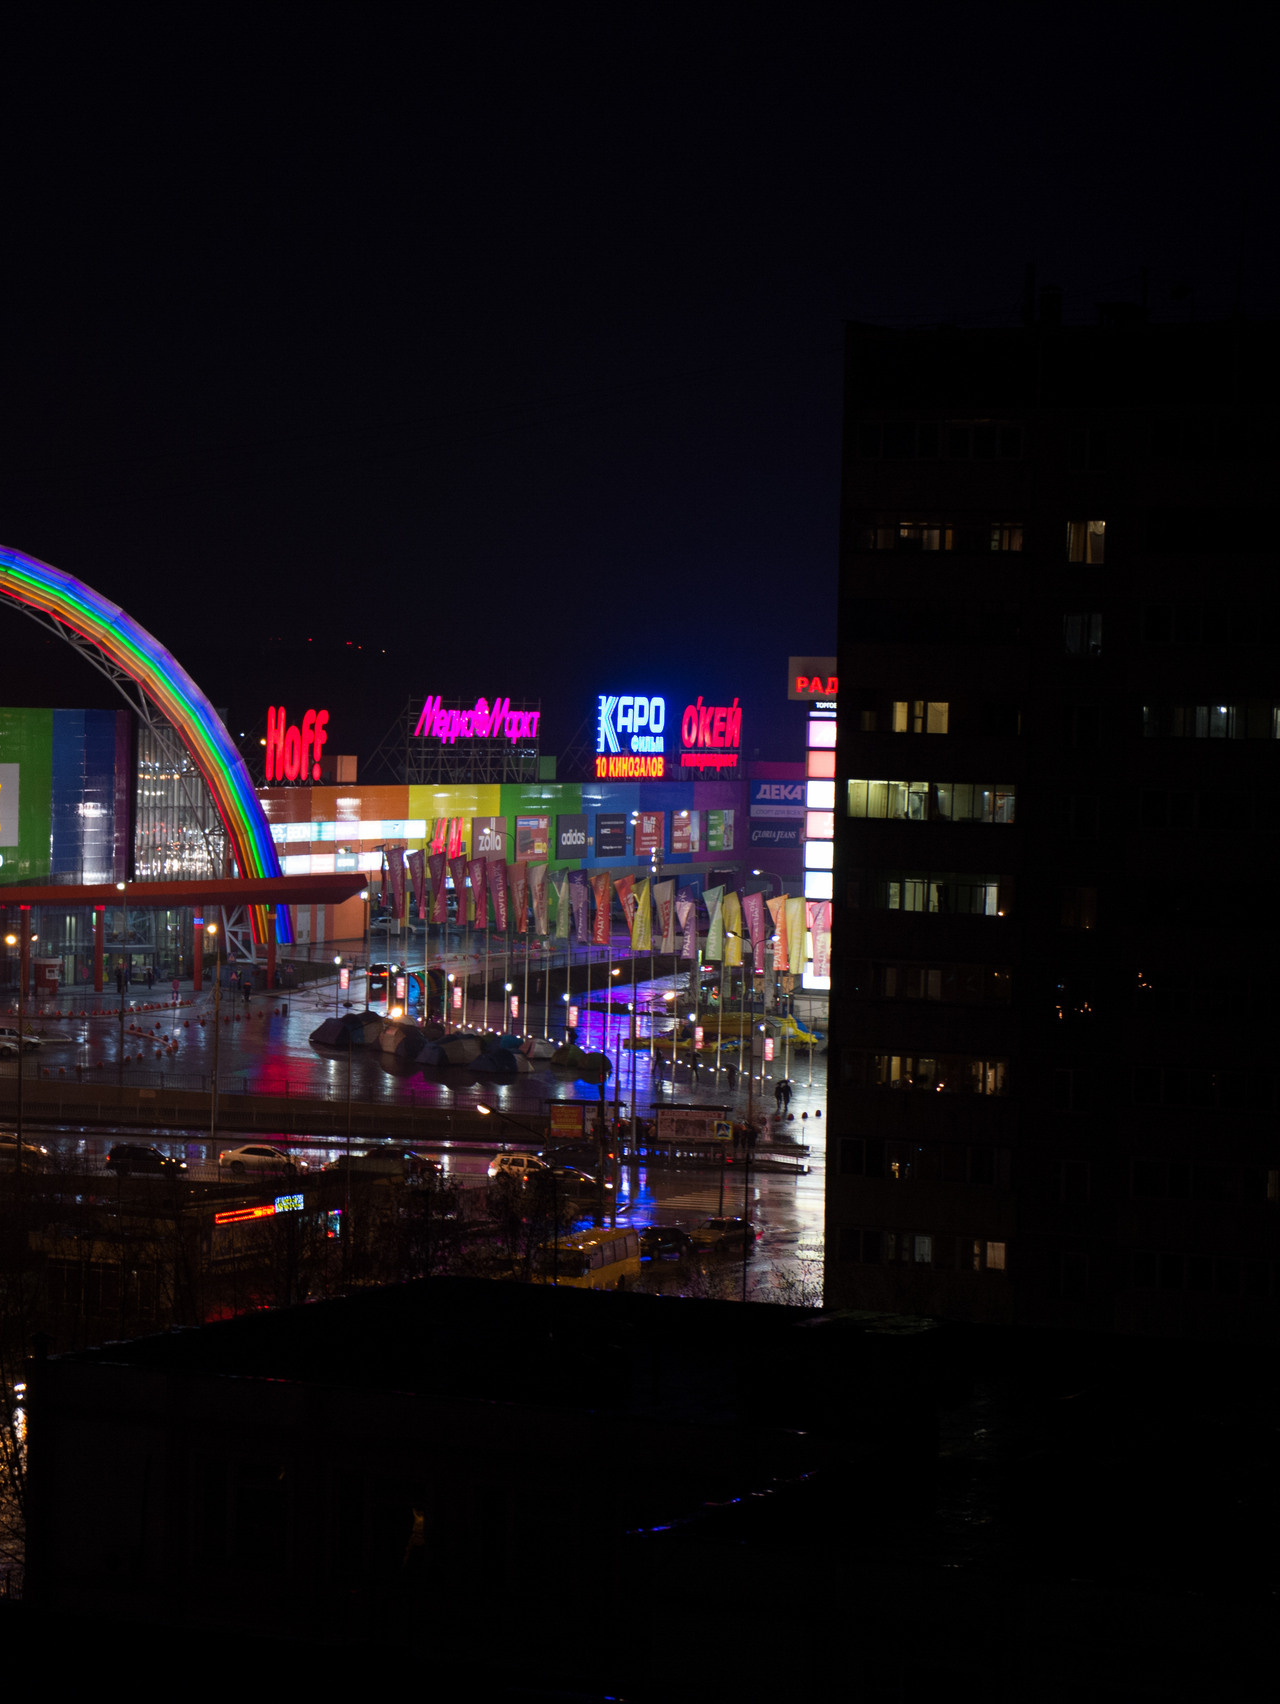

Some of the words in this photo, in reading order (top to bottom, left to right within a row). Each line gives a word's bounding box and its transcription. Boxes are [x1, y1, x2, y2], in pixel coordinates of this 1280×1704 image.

[596, 757, 607, 777] 10
[609, 756, 665, 777] КИНОЗАЛОВ
[756, 784, 807, 801] ДЕКА
[561, 828, 585, 846] adidas
